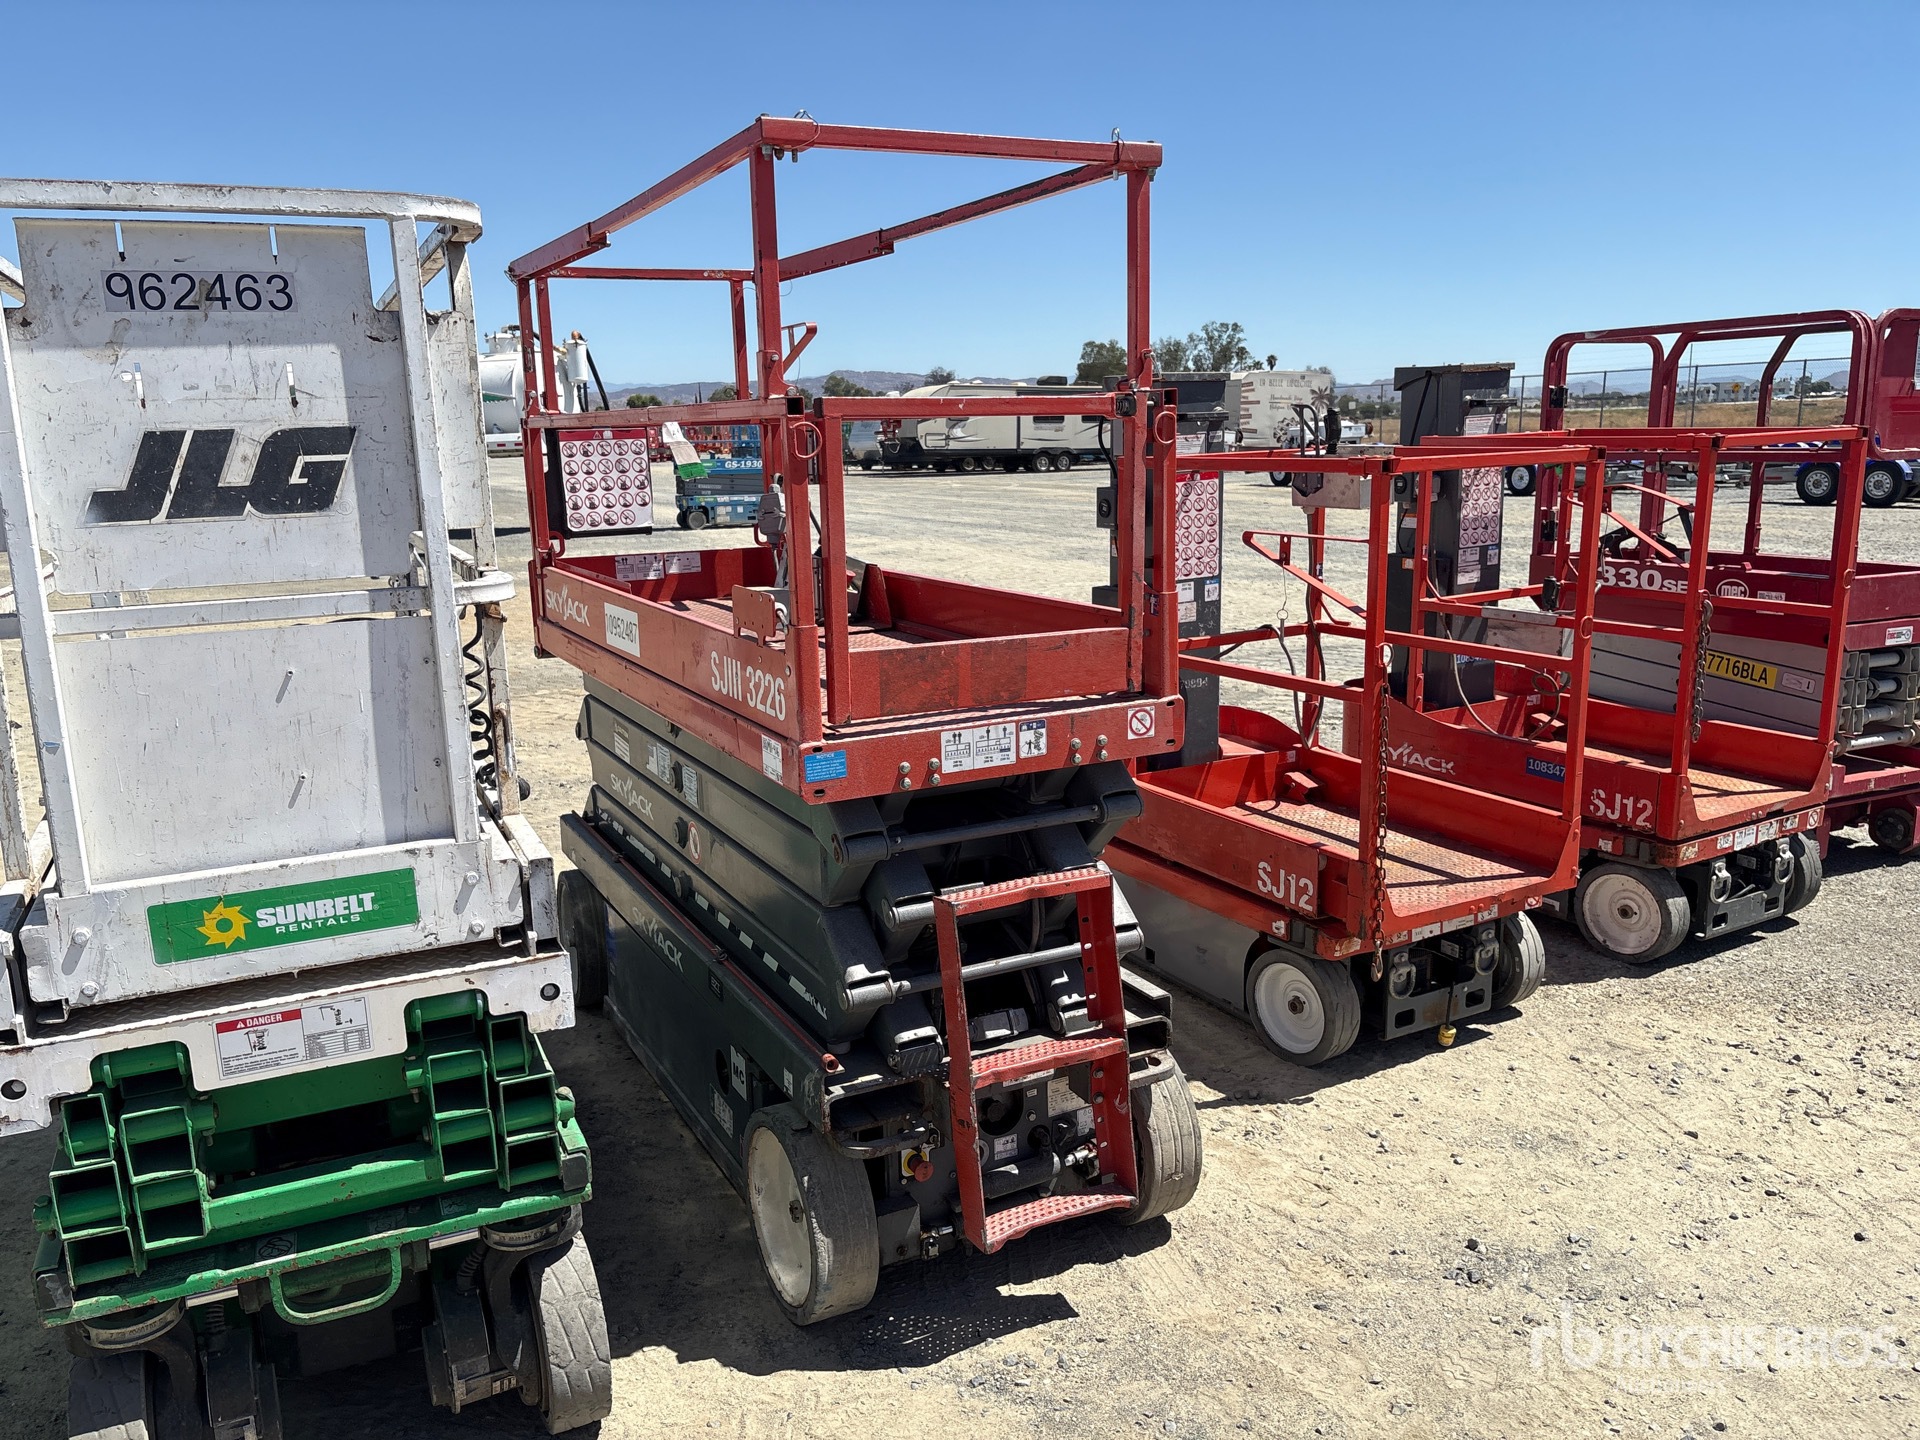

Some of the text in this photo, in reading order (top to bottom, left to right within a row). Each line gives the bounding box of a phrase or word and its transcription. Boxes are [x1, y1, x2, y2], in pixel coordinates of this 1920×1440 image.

[105, 271, 295, 311] 962463
[86, 427, 356, 523] JLG
[725, 460, 762, 468] GS-1930
[545, 584, 591, 627] SKYJACK
[1707, 653, 1768, 685] 7716BLA
[745, 665, 786, 721] 3226
[610, 773, 654, 821] SKYJACK
[1589, 788, 1653, 829] SJ12
[1257, 861, 1314, 911] SJ12
[256, 891, 375, 929] SUNBELT
[275, 914, 361, 934] RENTALS
[246, 1013, 283, 1028] DANGER
